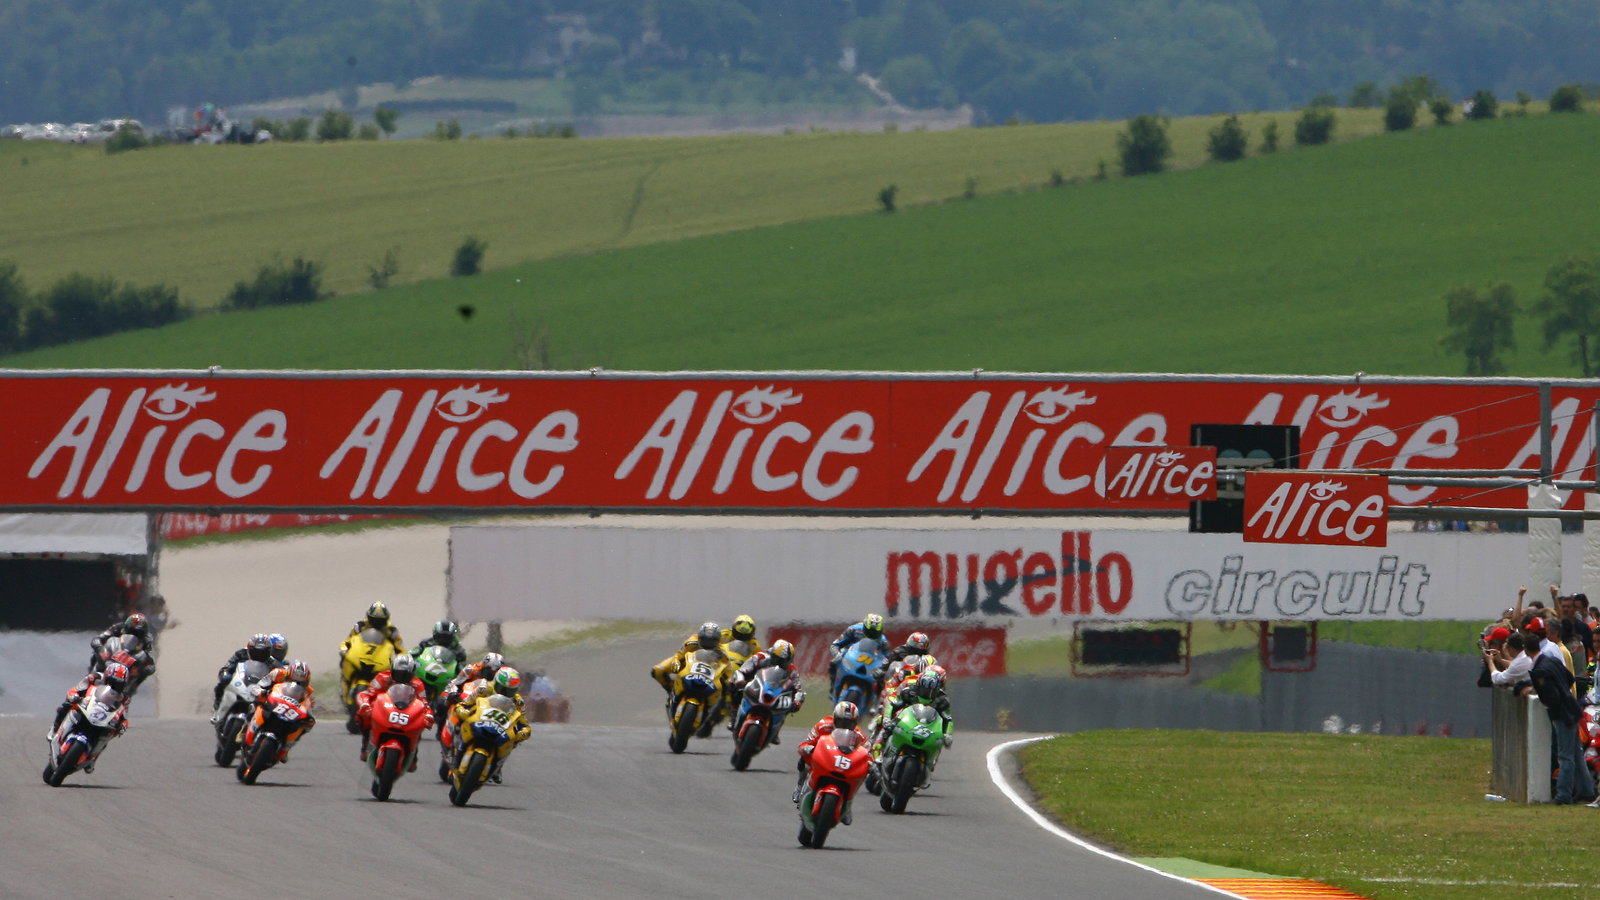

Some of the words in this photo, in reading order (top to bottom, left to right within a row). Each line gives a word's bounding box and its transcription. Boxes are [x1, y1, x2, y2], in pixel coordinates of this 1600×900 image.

[27, 383, 288, 499] Alice
[319, 384, 580, 500] Alice
[613, 385, 875, 502] Alice
[1243, 388, 1459, 505] ice
[1107, 451, 1214, 498] Alice
[1247, 480, 1384, 542] Alice
[884, 531, 1133, 618] mugello
[1164, 555, 1431, 617] circuit
[694, 662, 712, 677] 5
[272, 703, 300, 721] 69
[388, 711, 410, 726] 65
[482, 708, 510, 726] 46
[473, 720, 506, 739] CAMEL
[833, 755, 852, 770] 15
